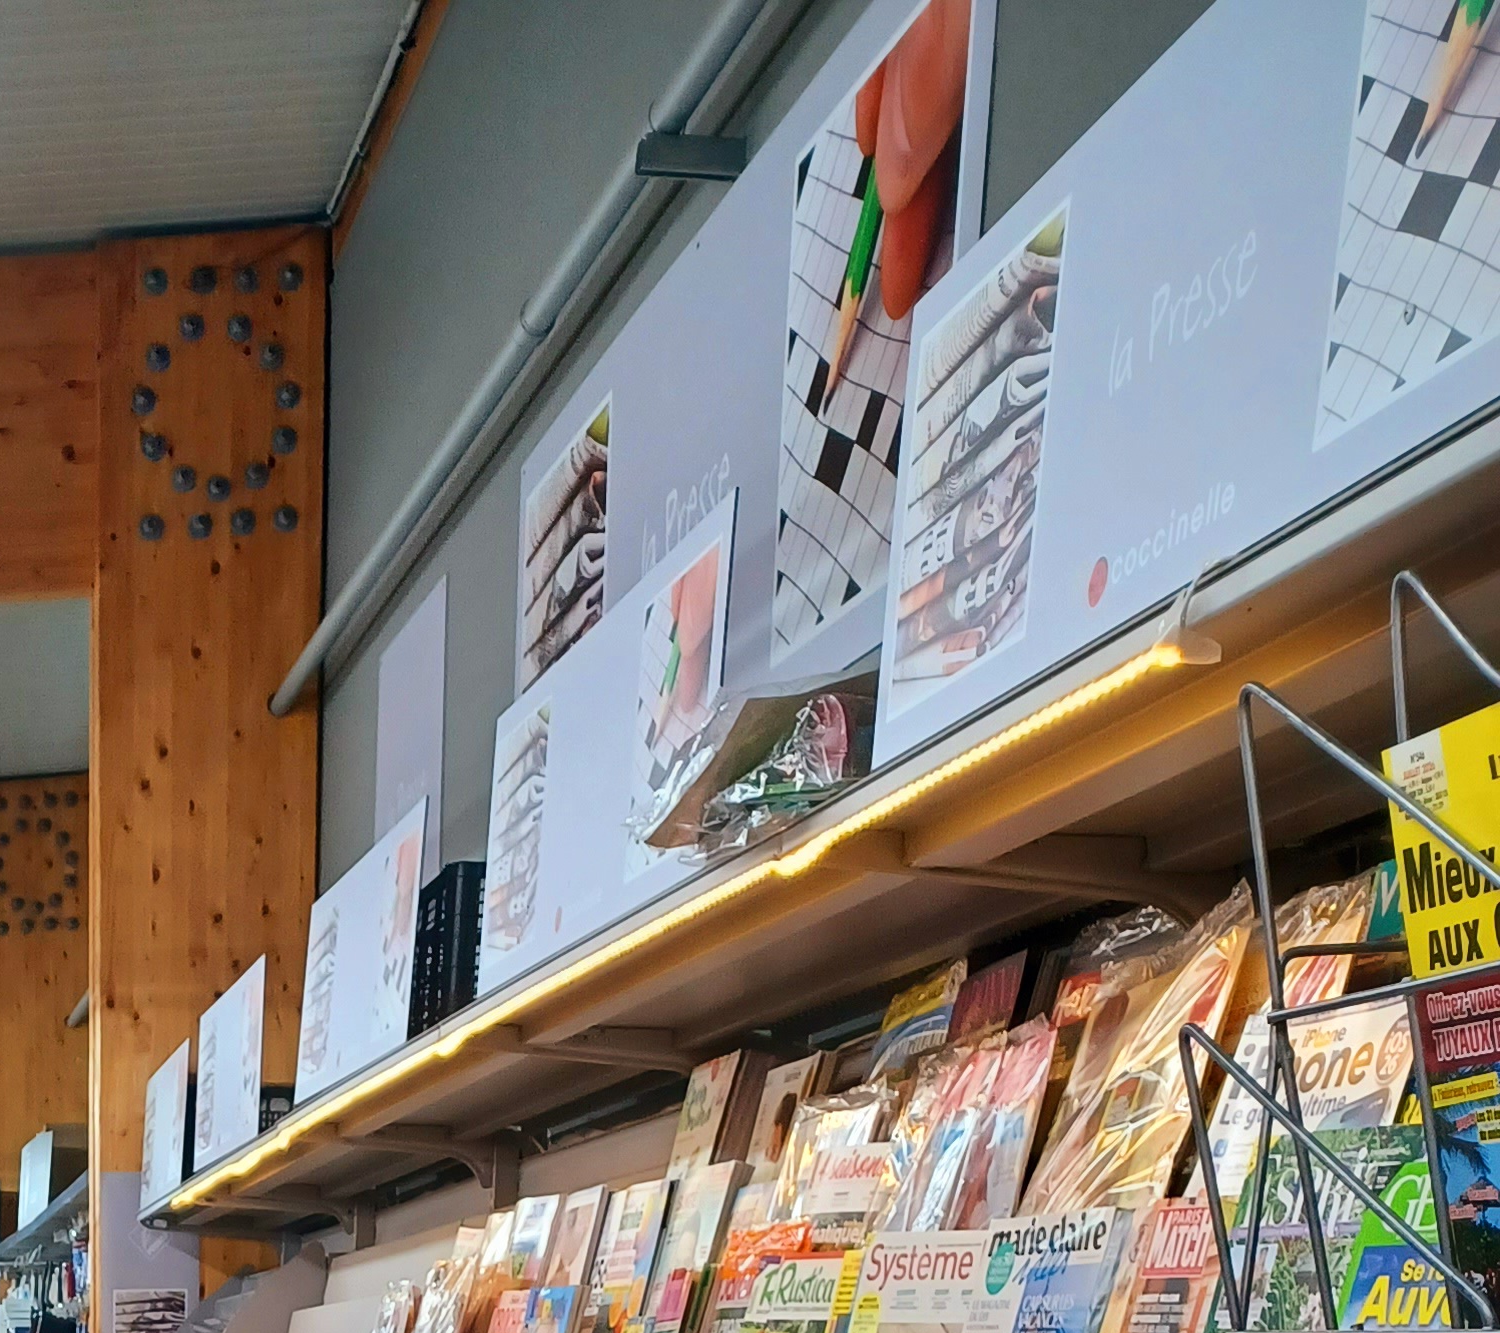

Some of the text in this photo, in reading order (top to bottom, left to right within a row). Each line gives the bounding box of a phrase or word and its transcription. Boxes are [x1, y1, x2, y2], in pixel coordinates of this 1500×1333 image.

[1107, 230, 1258, 398] la Presse
[1111, 480, 1237, 585] coccinelle
[1428, 918, 1484, 970] AUX
[1433, 1020, 1492, 1061] TUYAUX
[988, 1217, 1048, 1257] marie
[1145, 1209, 1213, 1269] MATCH
[866, 1243, 974, 1291] Système
